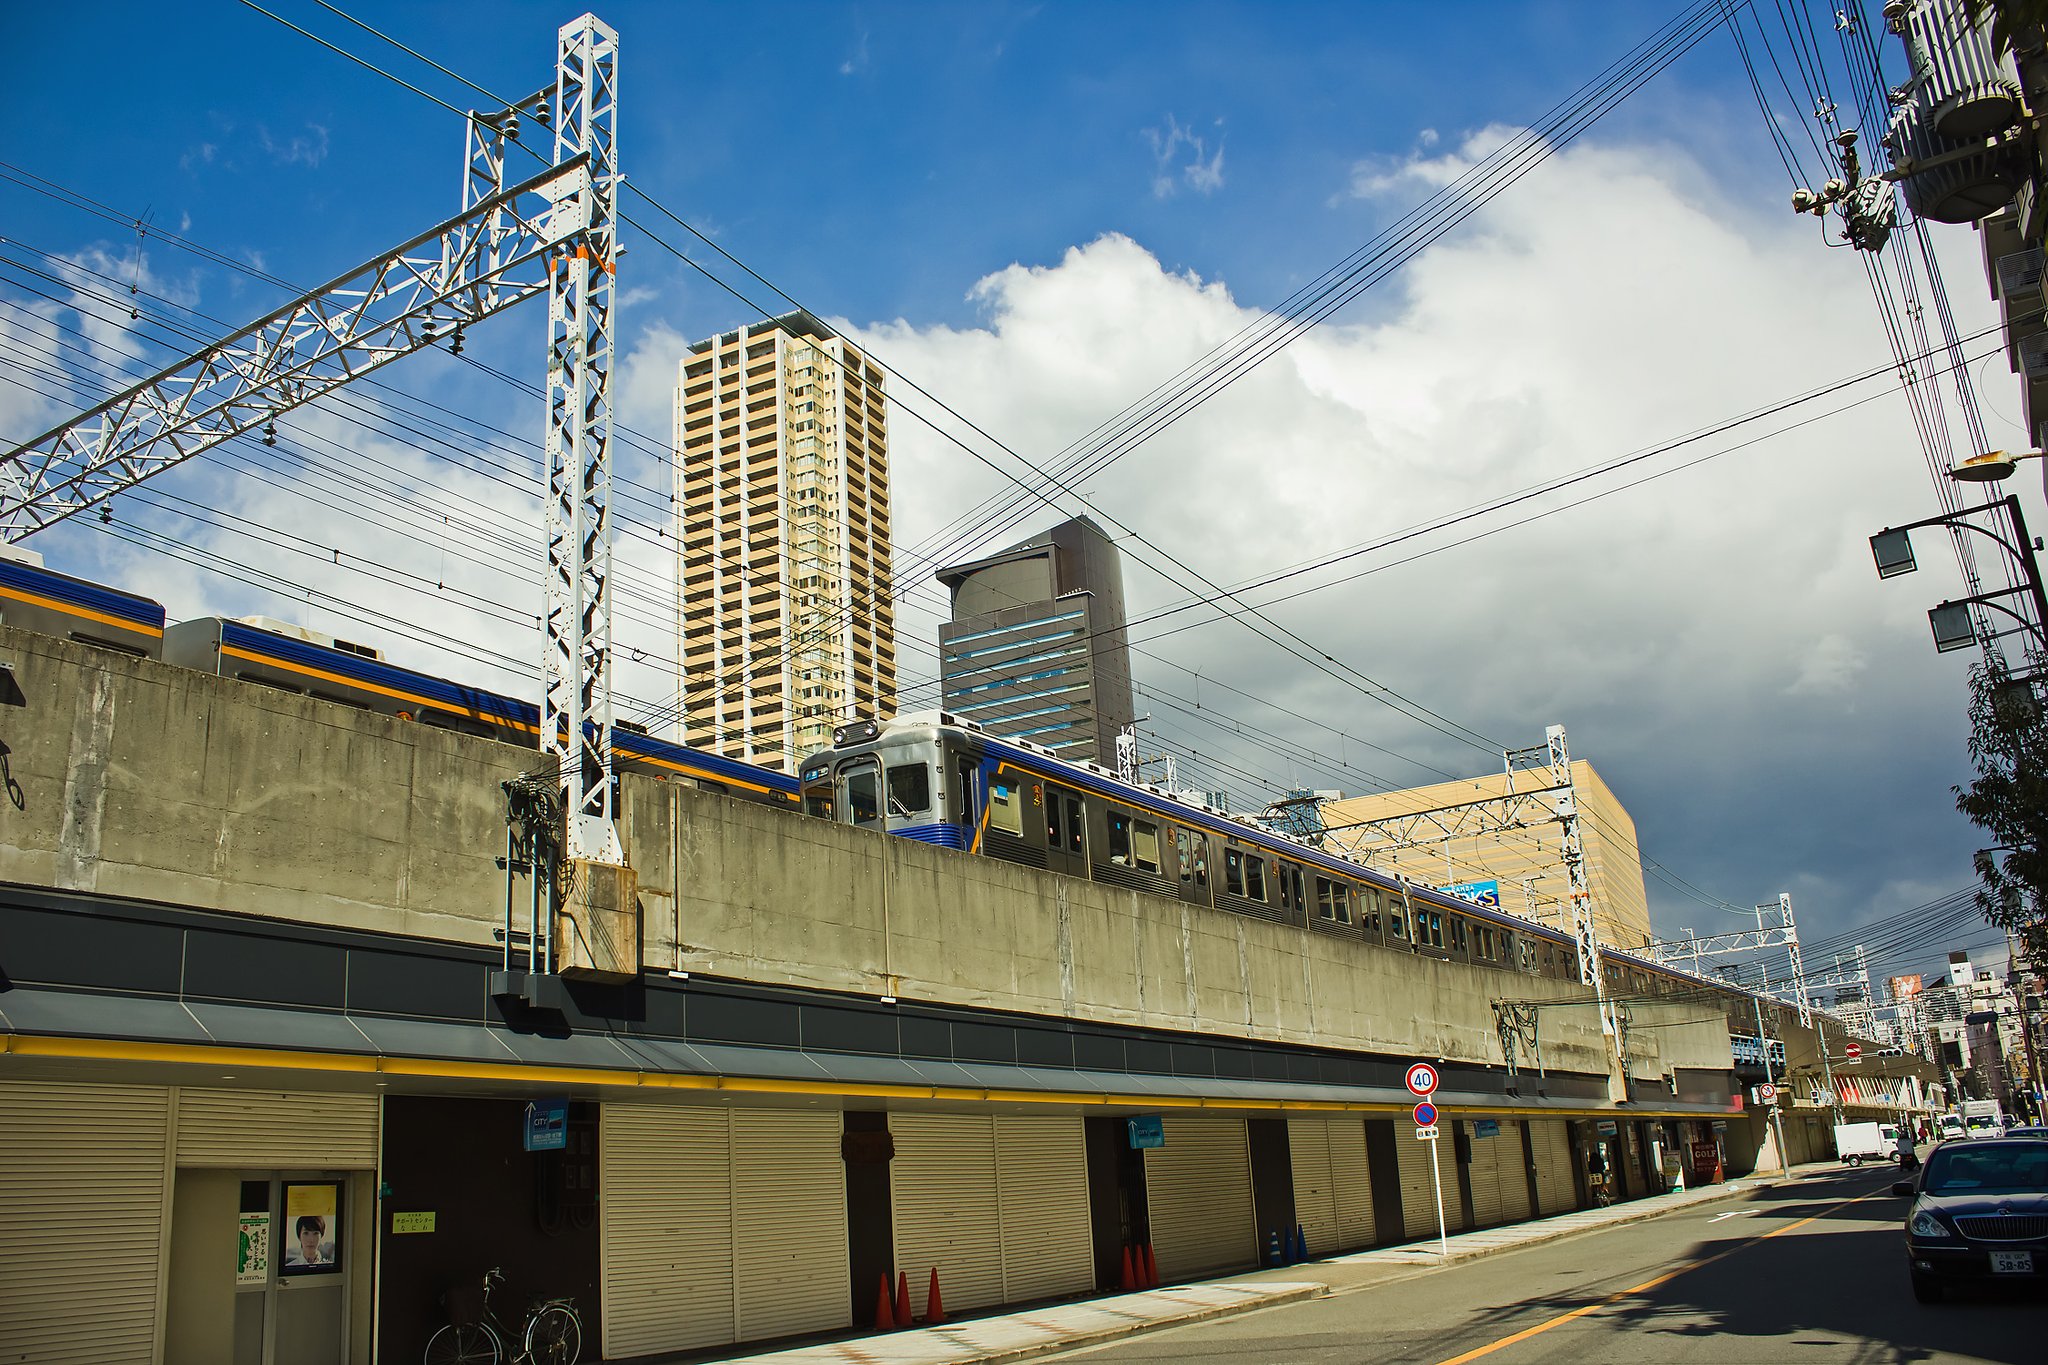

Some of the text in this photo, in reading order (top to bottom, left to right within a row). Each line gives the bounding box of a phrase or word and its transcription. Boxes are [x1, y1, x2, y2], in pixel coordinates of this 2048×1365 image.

[1452, 885, 1475, 894] AMBA
[1414, 1072, 1431, 1087] 40
[534, 1118, 548, 1126] CITY
[2033, 1118, 2040, 1126] P
[1695, 1150, 1717, 1158] GOLF
